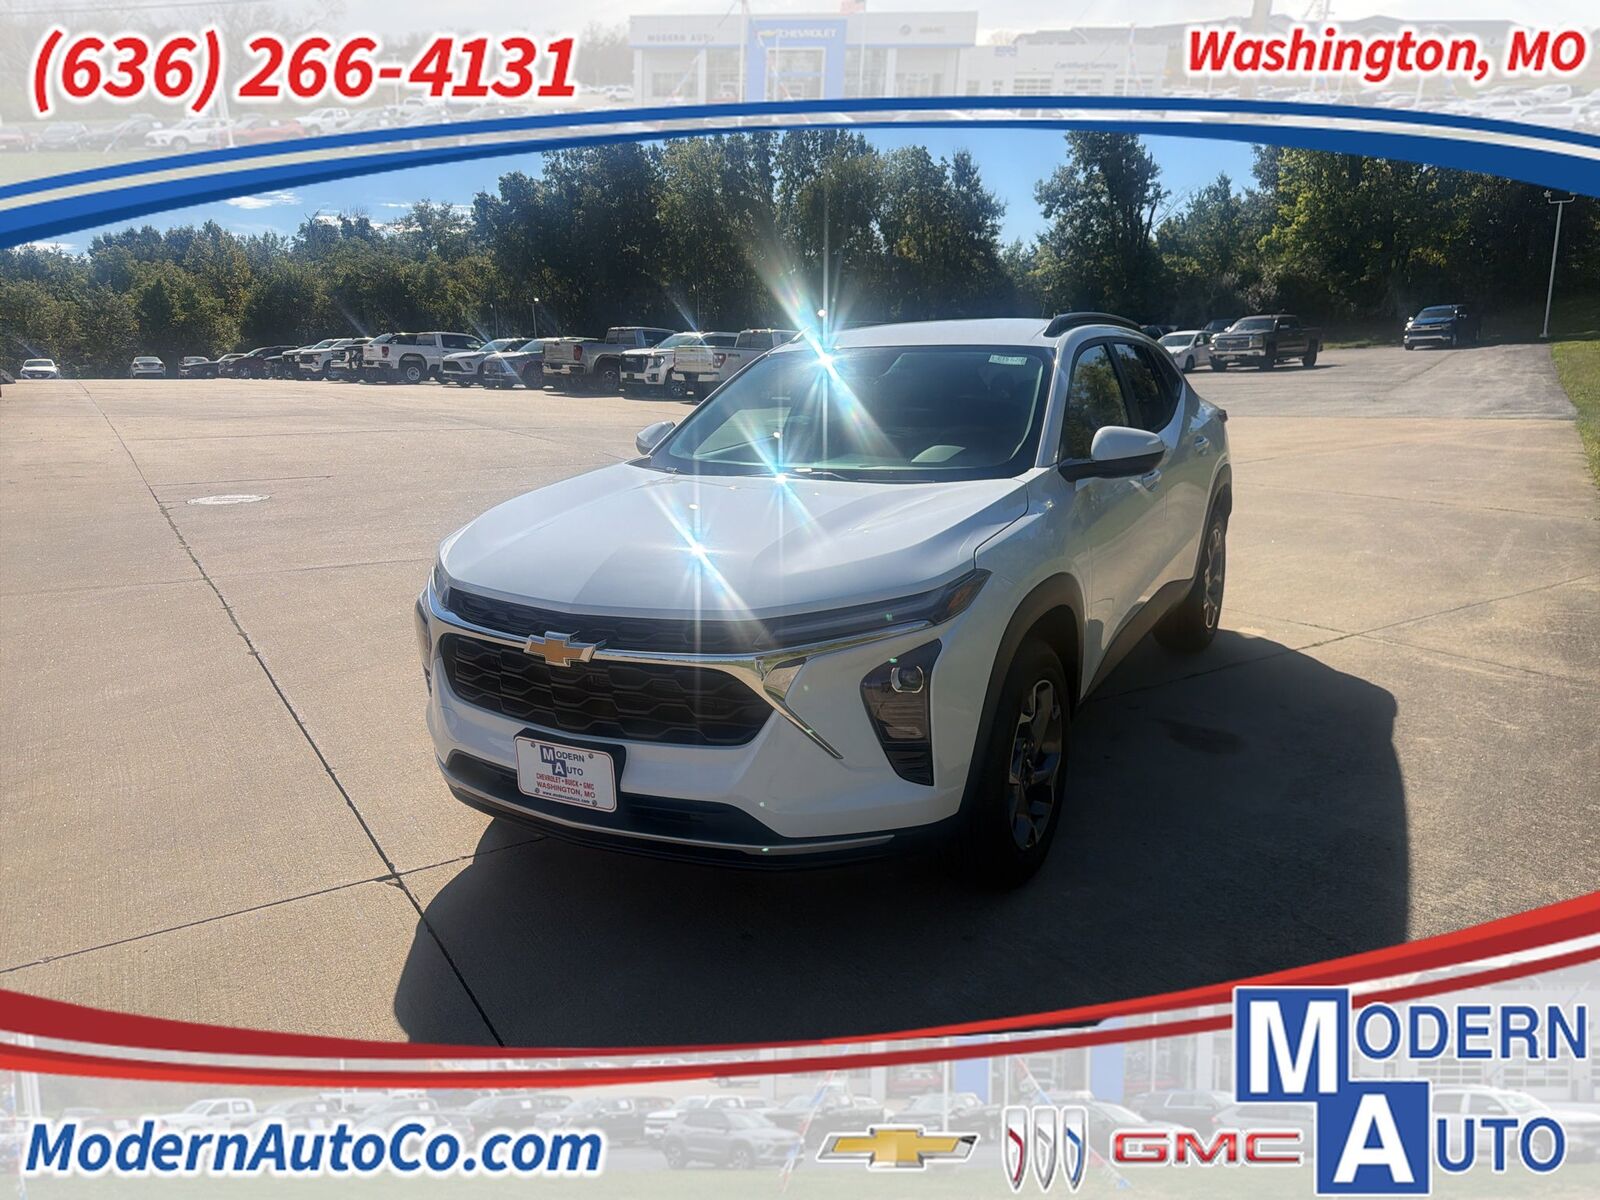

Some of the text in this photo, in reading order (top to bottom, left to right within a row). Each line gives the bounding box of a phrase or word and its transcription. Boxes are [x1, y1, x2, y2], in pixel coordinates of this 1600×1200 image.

[542, 746, 585, 763] MODERN
[554, 760, 584, 776] AUTO
[536, 772, 595, 791] CHEVROLET BUICK GMC
[536, 780, 596, 799] WASHINGTON, MO
